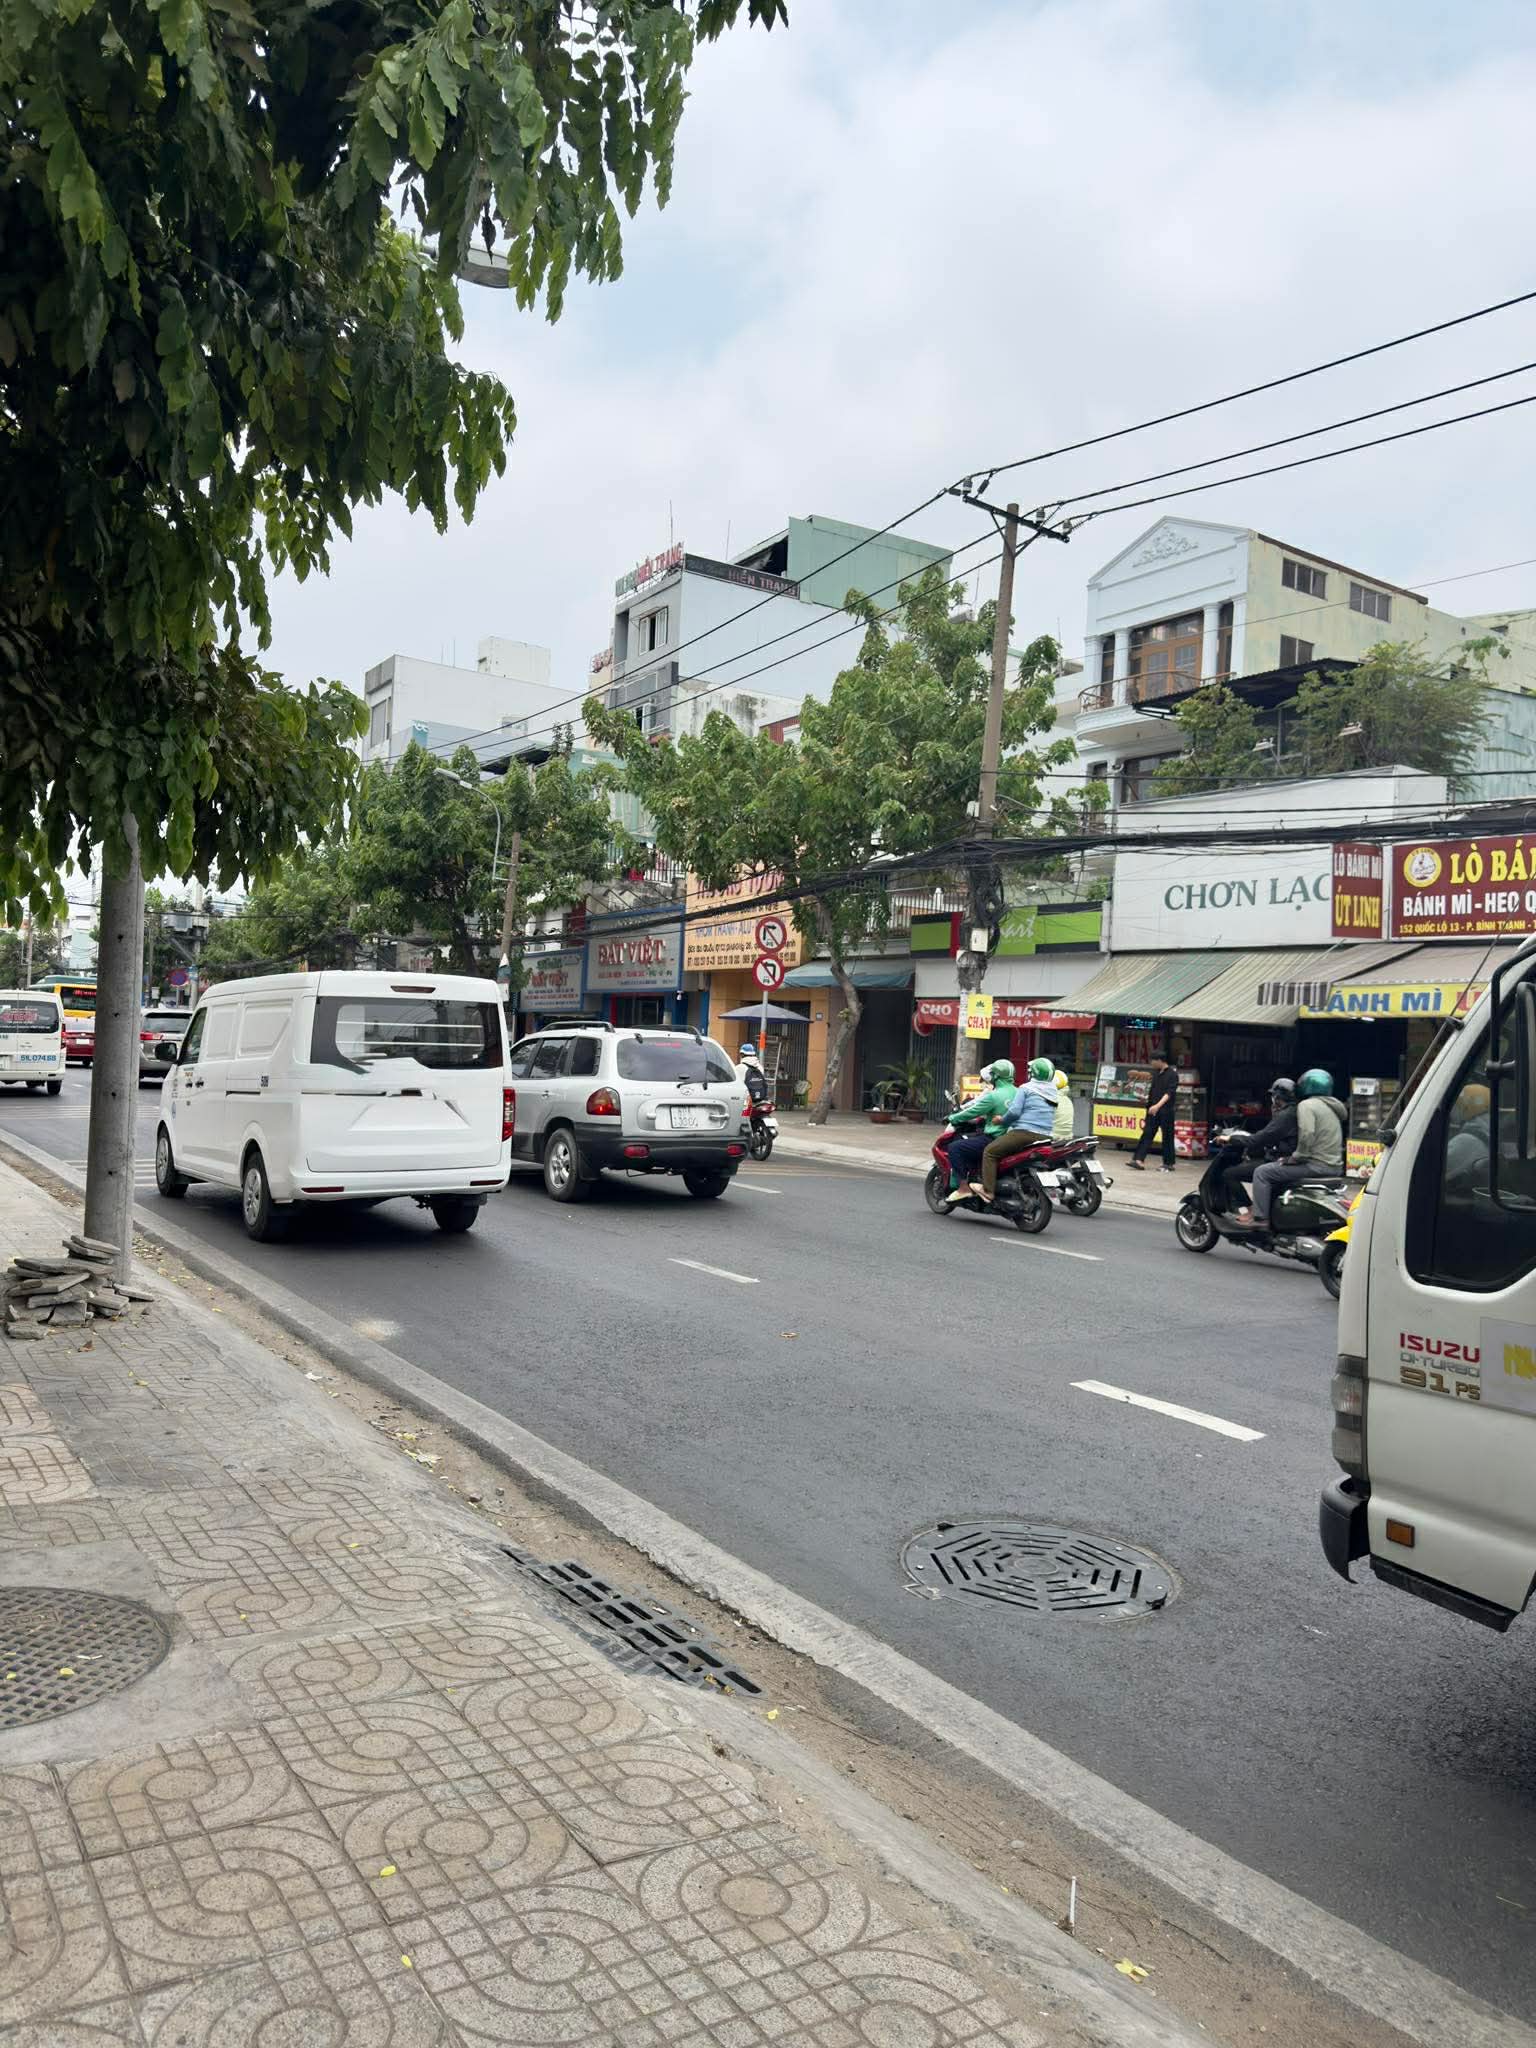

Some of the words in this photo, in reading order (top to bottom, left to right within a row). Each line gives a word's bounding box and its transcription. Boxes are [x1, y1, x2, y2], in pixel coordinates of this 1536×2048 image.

[1334, 846, 1344, 877] LÒ
[1347, 848, 1370, 879] BÁNH
[1371, 851, 1382, 880] MÌ
[1450, 843, 1483, 884] LÒ
[1164, 879, 1258, 911] CHƠN
[1335, 884, 1352, 927] ÚT
[1352, 894, 1381, 929] LINH
[1403, 891, 1446, 917] BÁNH
[1451, 889, 1472, 916] MÌ
[1484, 891, 1520, 914] HEO
[1400, 924, 1413, 934] 152
[1414, 920, 1436, 934] QUỐC
[1436, 922, 1448, 934] LỘ
[1450, 922, 1460, 932] 13
[1476, 919, 1496, 931] BÌNH
[920, 1003, 952, 1016] CHO
[1402, 988, 1443, 1012] MÌ
[1097, 1111, 1123, 1129] BÁNH
[1126, 1114, 1137, 1131] MÌ
[1400, 1332, 1480, 1363] ISUZU
[1400, 1352, 1480, 1378] DI-TURBO
[1400, 1365, 1450, 1394] 91
[1455, 1381, 1480, 1401] PS
